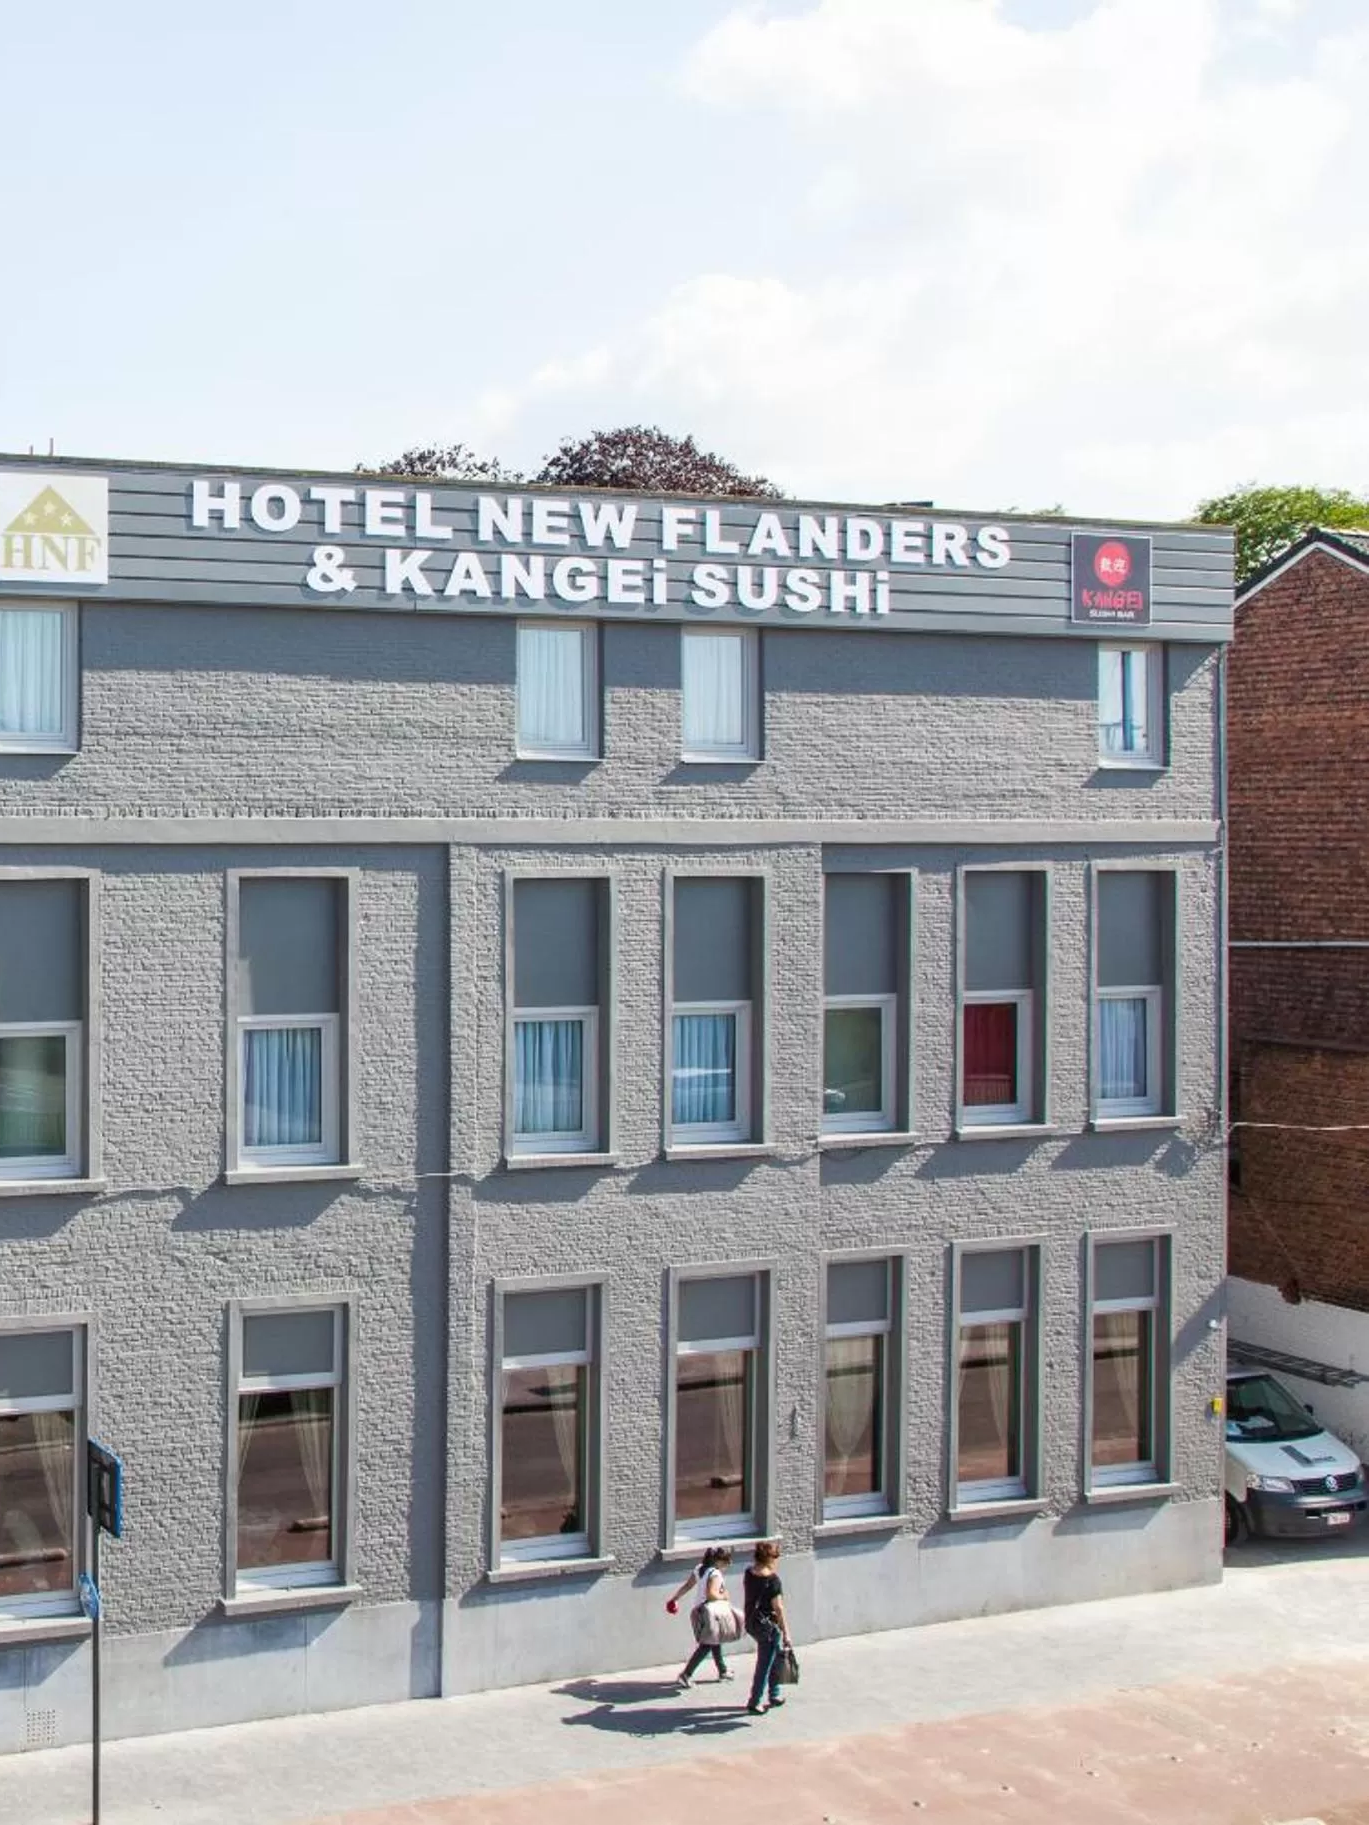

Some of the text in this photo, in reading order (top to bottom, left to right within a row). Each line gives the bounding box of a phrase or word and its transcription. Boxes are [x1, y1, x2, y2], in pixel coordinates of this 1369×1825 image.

[192, 479, 1012, 568] HOTEL NEW FLANDERS
[0, 533, 102, 572] HNF
[305, 545, 358, 593] &
